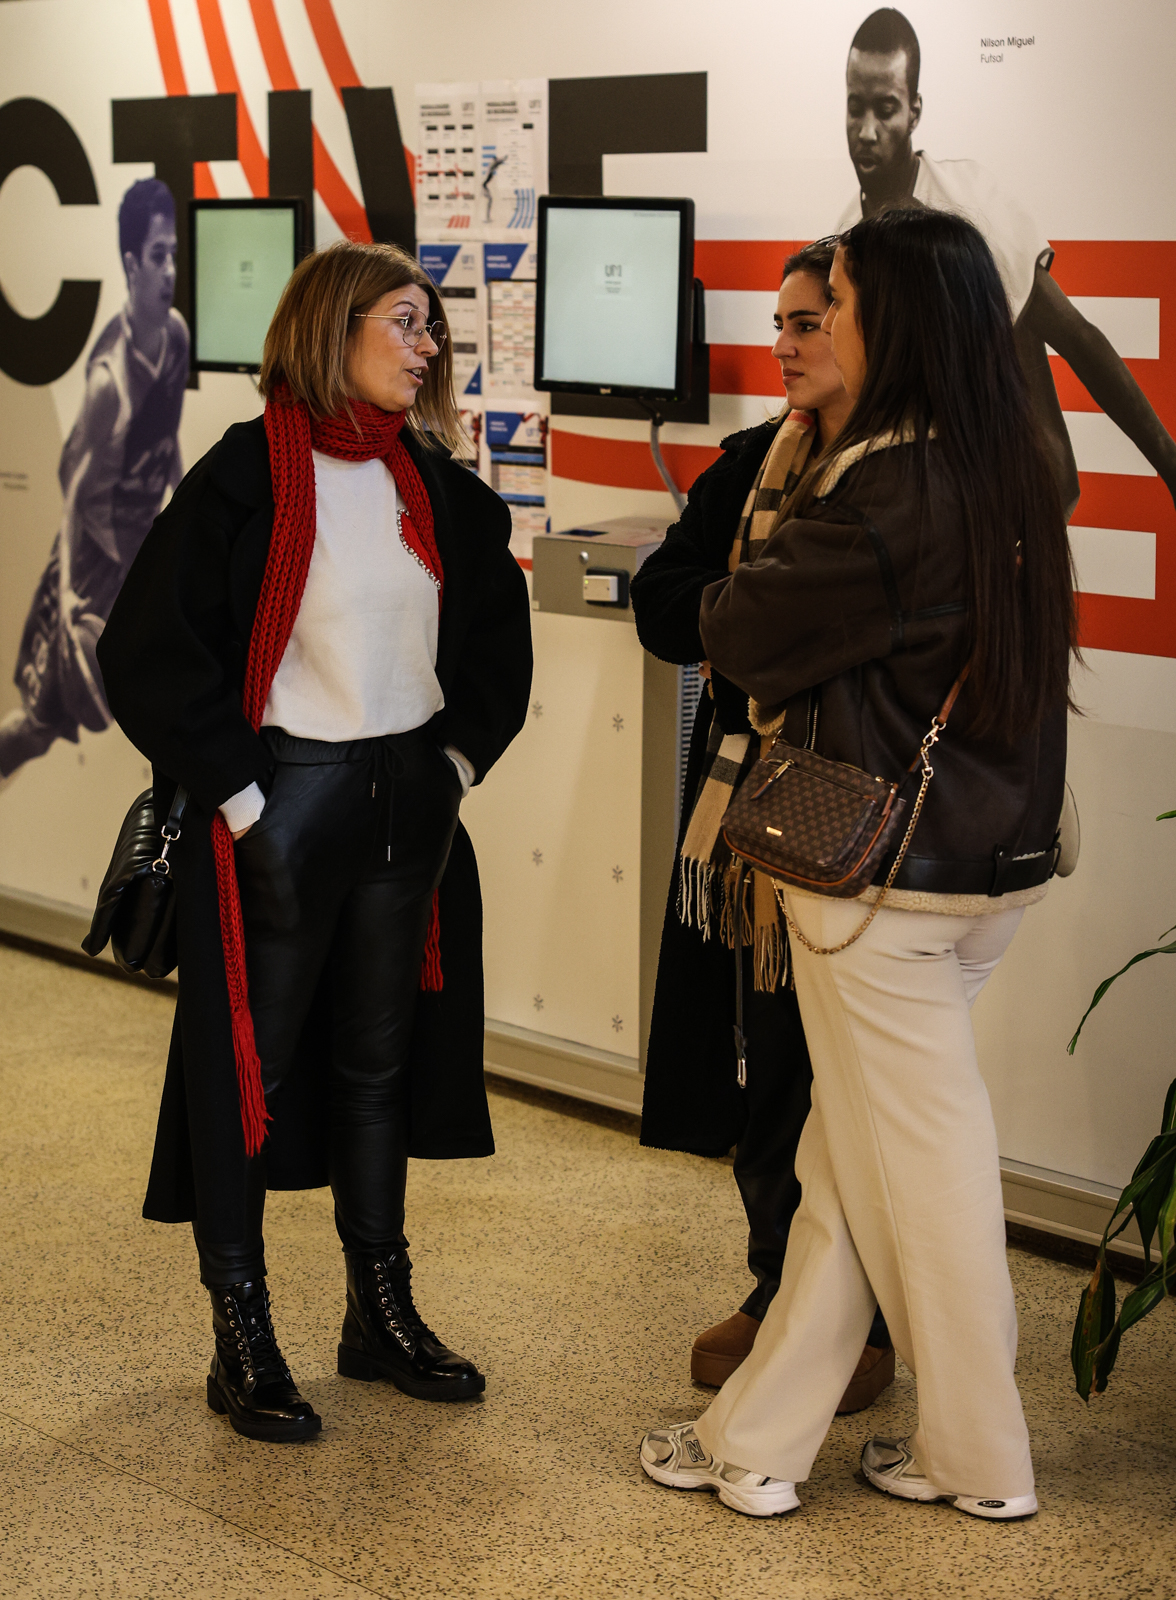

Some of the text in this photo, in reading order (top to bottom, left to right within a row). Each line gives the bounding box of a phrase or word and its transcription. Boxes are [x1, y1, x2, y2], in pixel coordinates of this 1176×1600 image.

[980, 35, 1035, 48] Nilson Miguel
[980, 53, 1004, 63] Futsal
[685, 1439, 706, 1462] N
